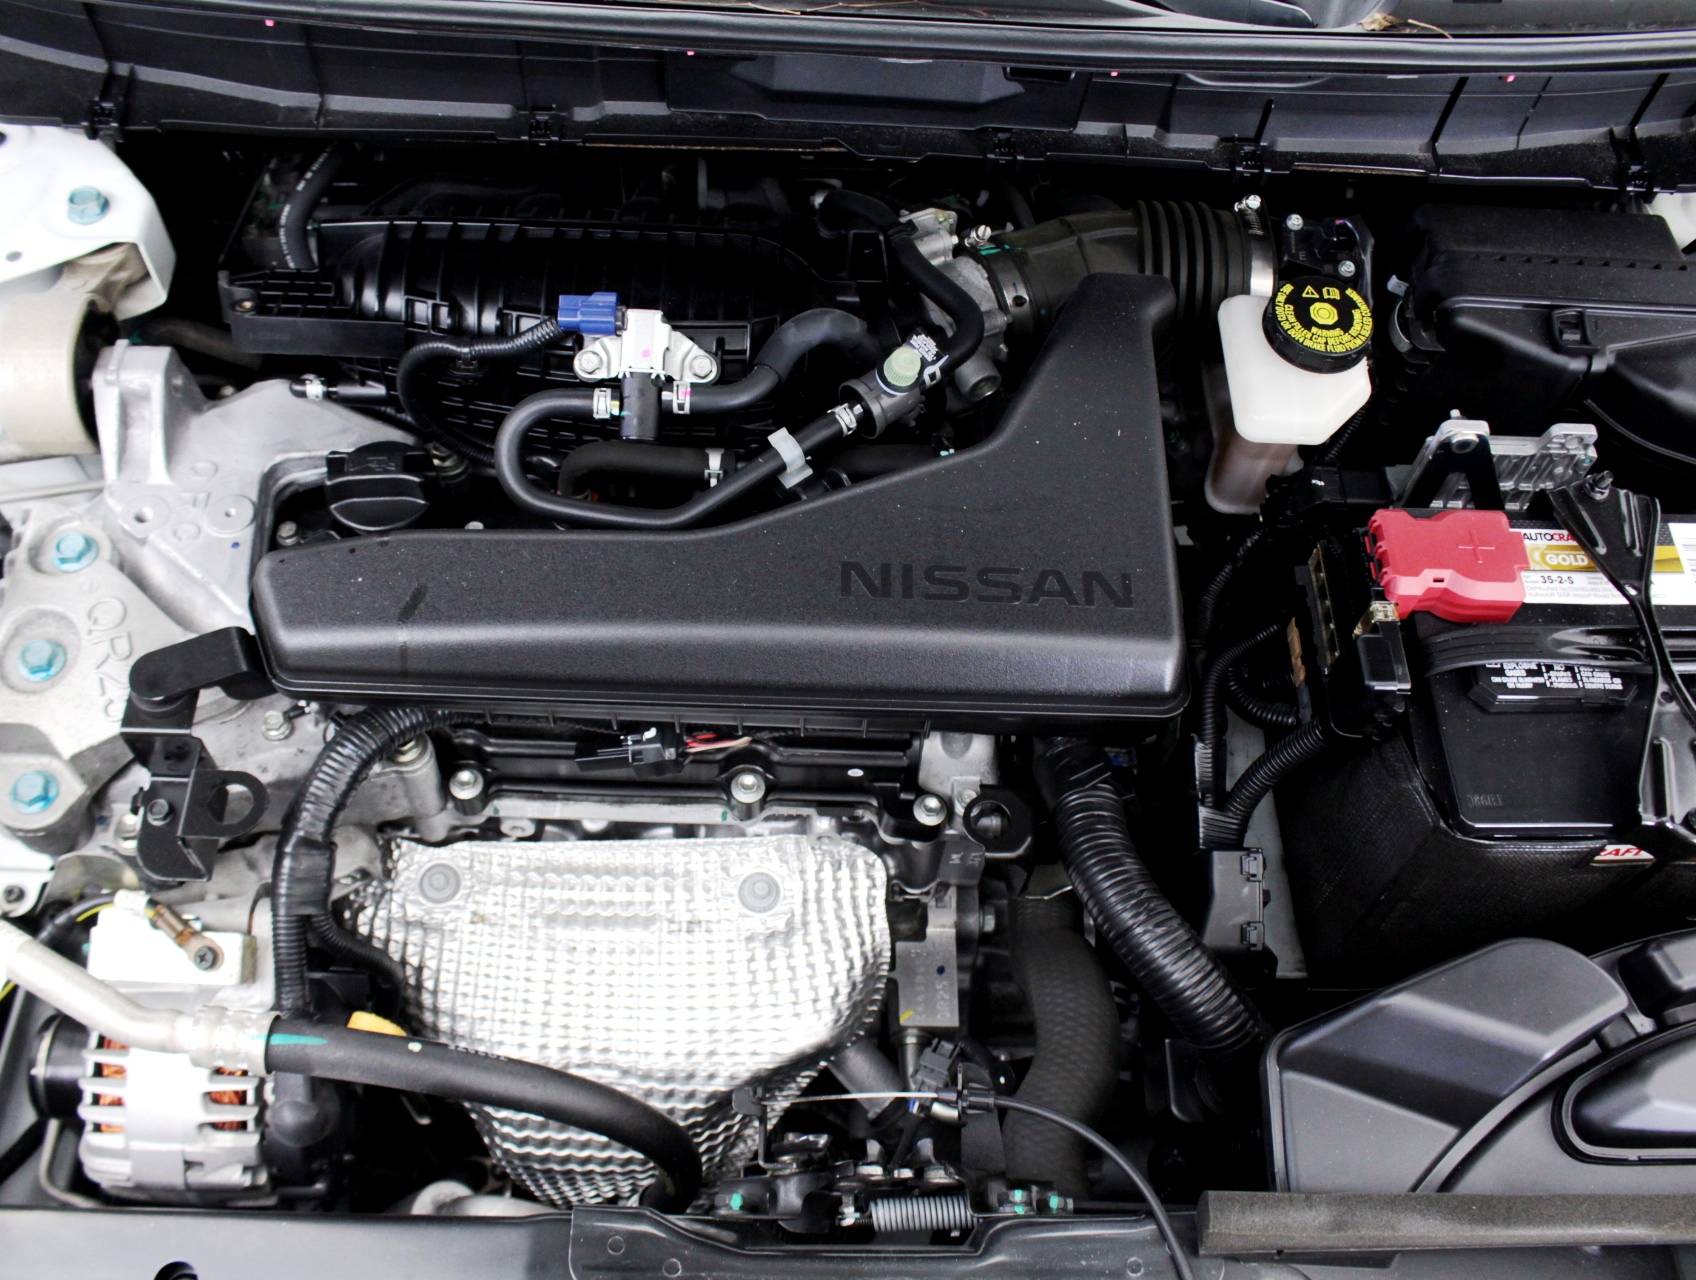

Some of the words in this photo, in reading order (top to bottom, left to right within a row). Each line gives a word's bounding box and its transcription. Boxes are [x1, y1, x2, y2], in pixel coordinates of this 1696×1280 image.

[1292, 322, 1312, 339] FILLER
[1312, 335, 1326, 344] CAP
[1327, 332, 1354, 345] BEFORE
[1311, 326, 1344, 337] WARNING
[1303, 338, 1326, 352] BRAKE
[1327, 344, 1346, 352] FLUID
[1345, 337, 1363, 350] FROM
[1523, 532, 1577, 541] AUTOCRA
[1546, 554, 1589, 566] GOLD
[840, 560, 1134, 609] NISSAN
[1540, 575, 1574, 585] 35-2-S
